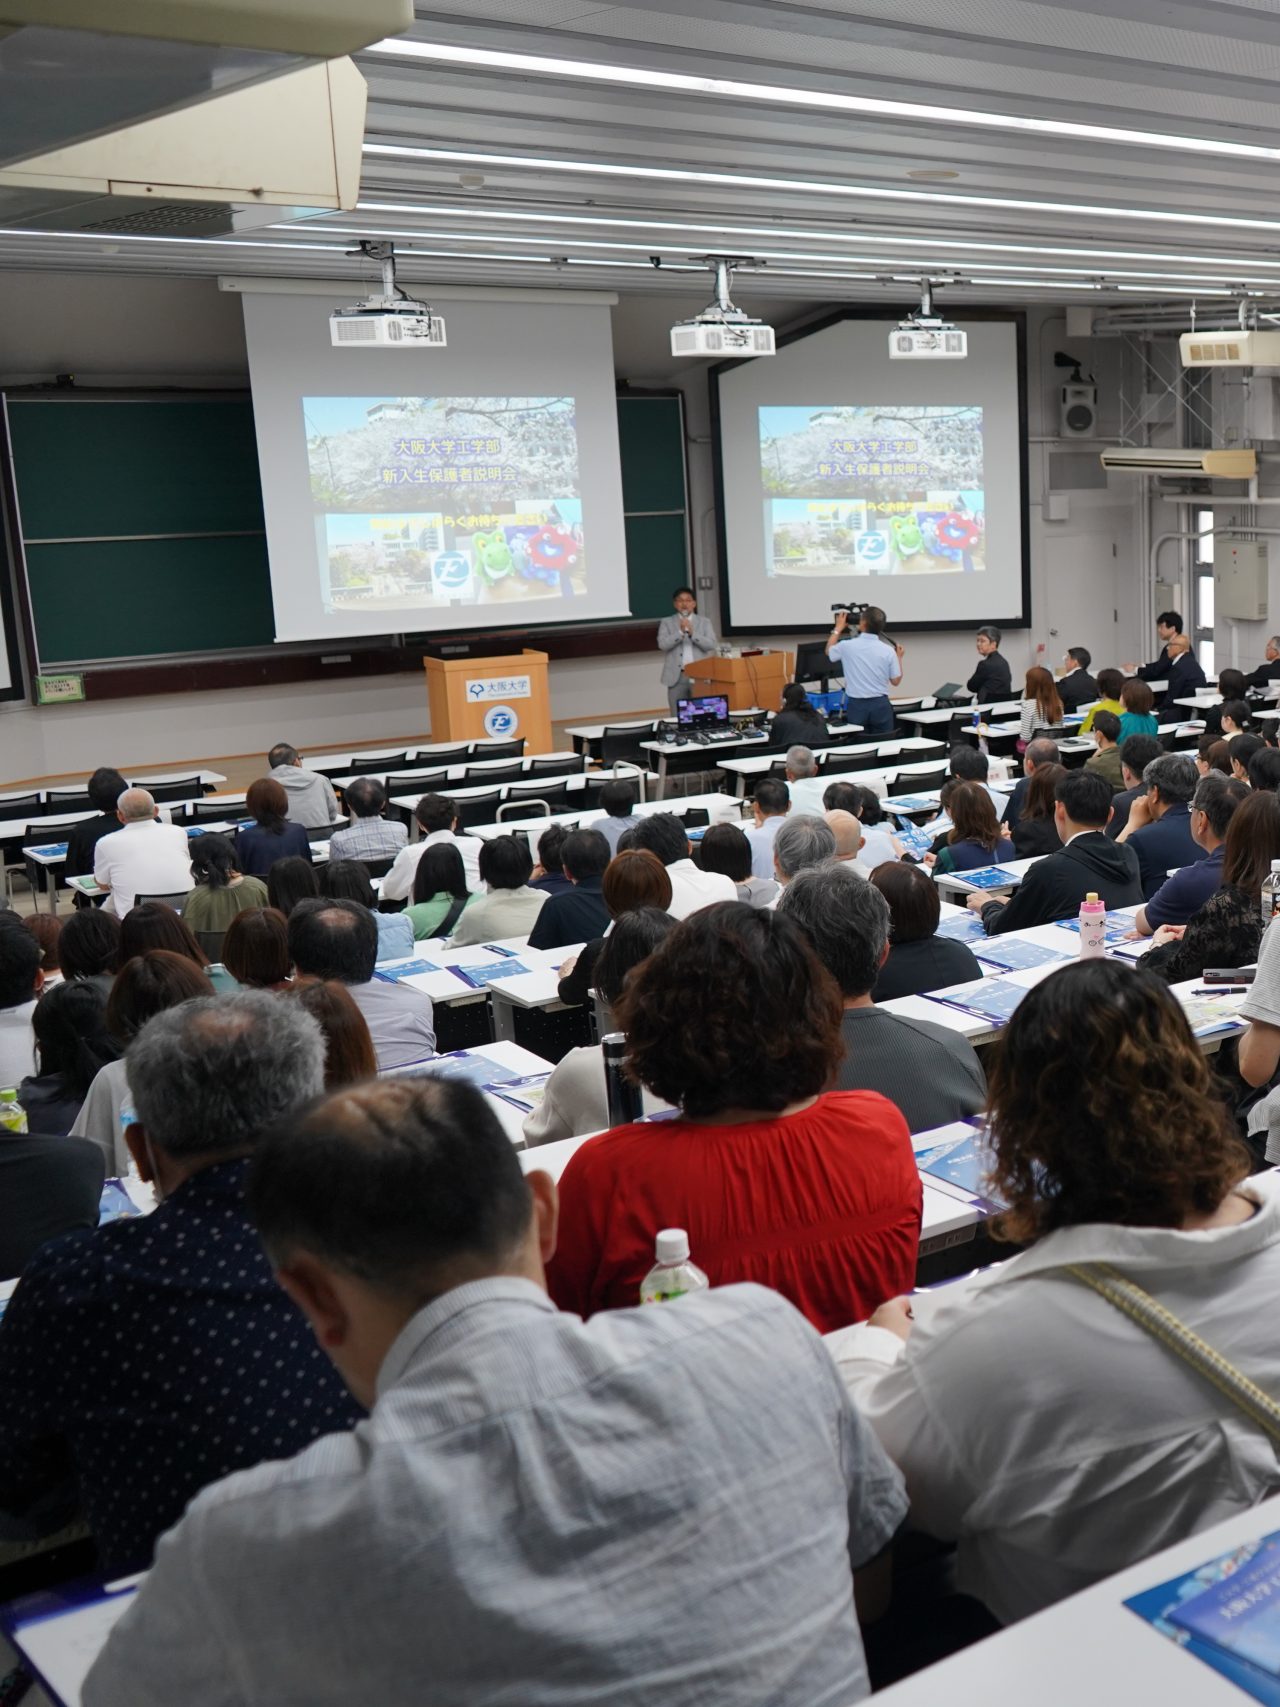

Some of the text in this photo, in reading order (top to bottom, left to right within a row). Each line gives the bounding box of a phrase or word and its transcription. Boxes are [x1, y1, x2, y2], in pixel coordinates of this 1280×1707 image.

[396, 438, 500, 456] 大阪大学工学部
[831, 439, 918, 453] 大阪大学工学部
[382, 465, 518, 484] 新入生保護者説明会
[818, 462, 930, 476] 新入生保護者説明会
[487, 680, 528, 693] 大阪大学
